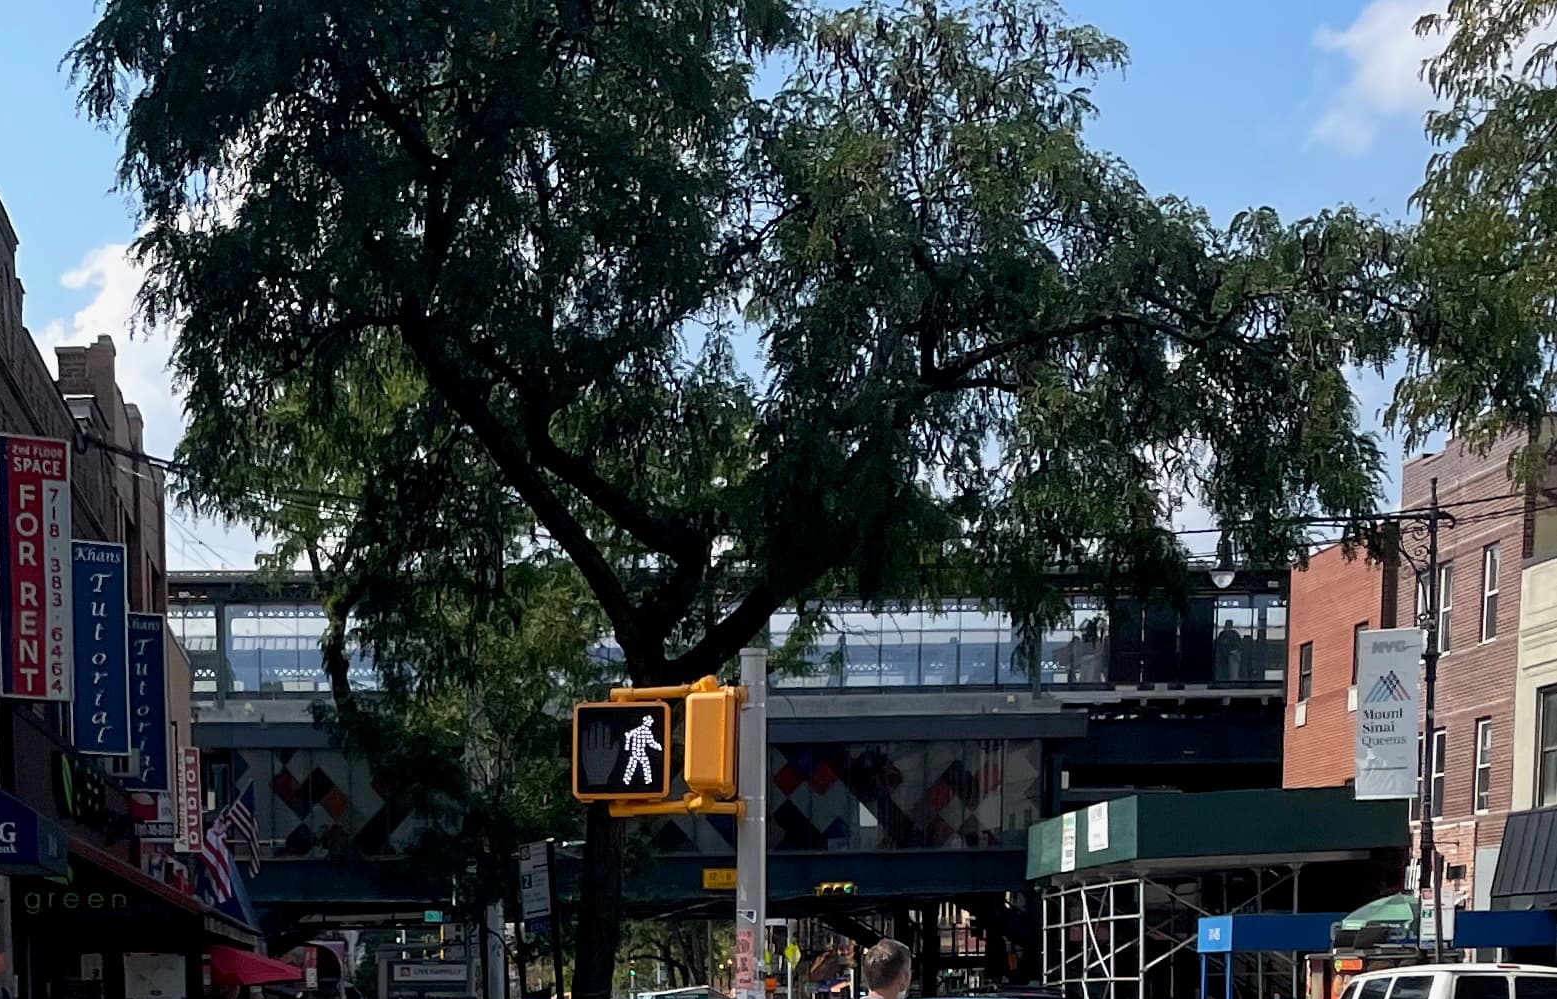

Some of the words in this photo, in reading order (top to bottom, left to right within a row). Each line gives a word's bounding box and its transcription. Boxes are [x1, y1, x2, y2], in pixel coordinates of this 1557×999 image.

[13, 457, 61, 476] SPACE
[15, 484, 39, 567] FOR
[75, 547, 122, 564] Khans
[18, 582, 39, 693] RENT
[89, 574, 113, 745] Tutorial
[1363, 708, 1403, 720] Mount
[1362, 722, 1395, 733] Sinai
[1361, 735, 1407, 748] Queens
[24, 891, 127, 914] green
